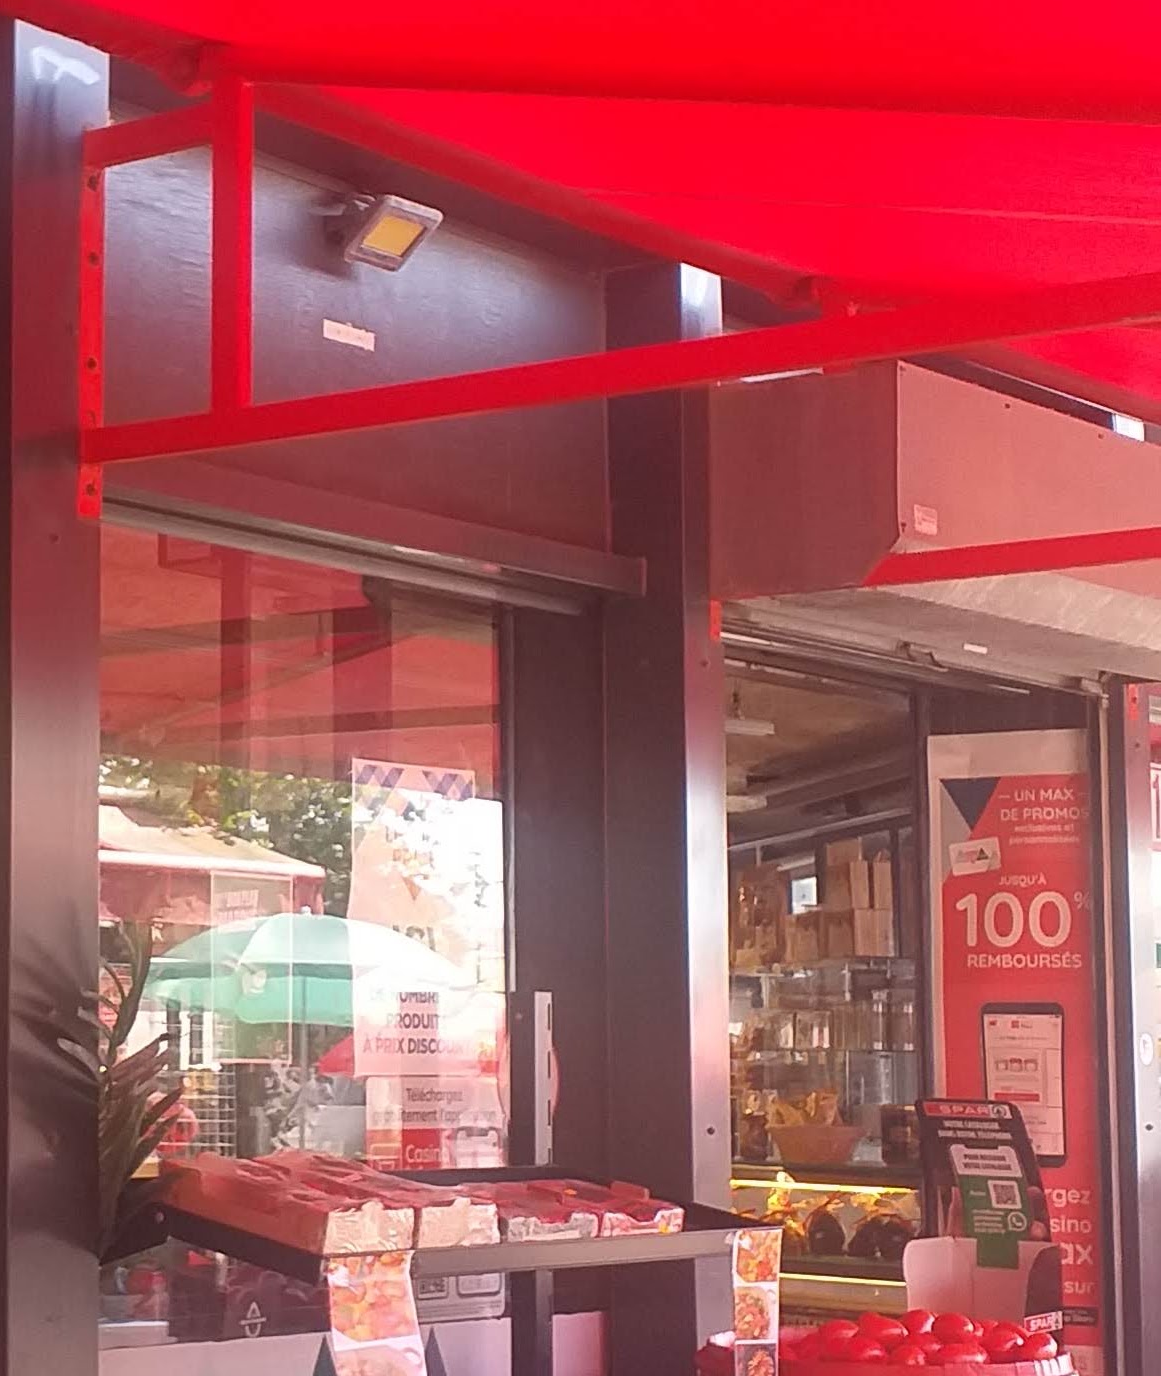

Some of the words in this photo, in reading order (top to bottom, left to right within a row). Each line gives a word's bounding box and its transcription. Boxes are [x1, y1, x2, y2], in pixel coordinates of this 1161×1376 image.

[1014, 788, 1036, 802] UN
[1040, 787, 1074, 801] MAX
[1001, 807, 1019, 821] DE
[1024, 806, 1089, 821] PROMOS
[998, 872, 1047, 887] JUSQU'À
[967, 951, 1083, 969] REMBOURSÉS
[939, 1103, 989, 1115] SPAR
[406, 1143, 443, 1163] Casin
[1045, 1188, 1090, 1207] rgez
[1050, 1215, 1091, 1232] sino
[1060, 1241, 1094, 1265] ax
[1064, 1280, 1094, 1294] sur
[1030, 1315, 1053, 1332] SPAR
